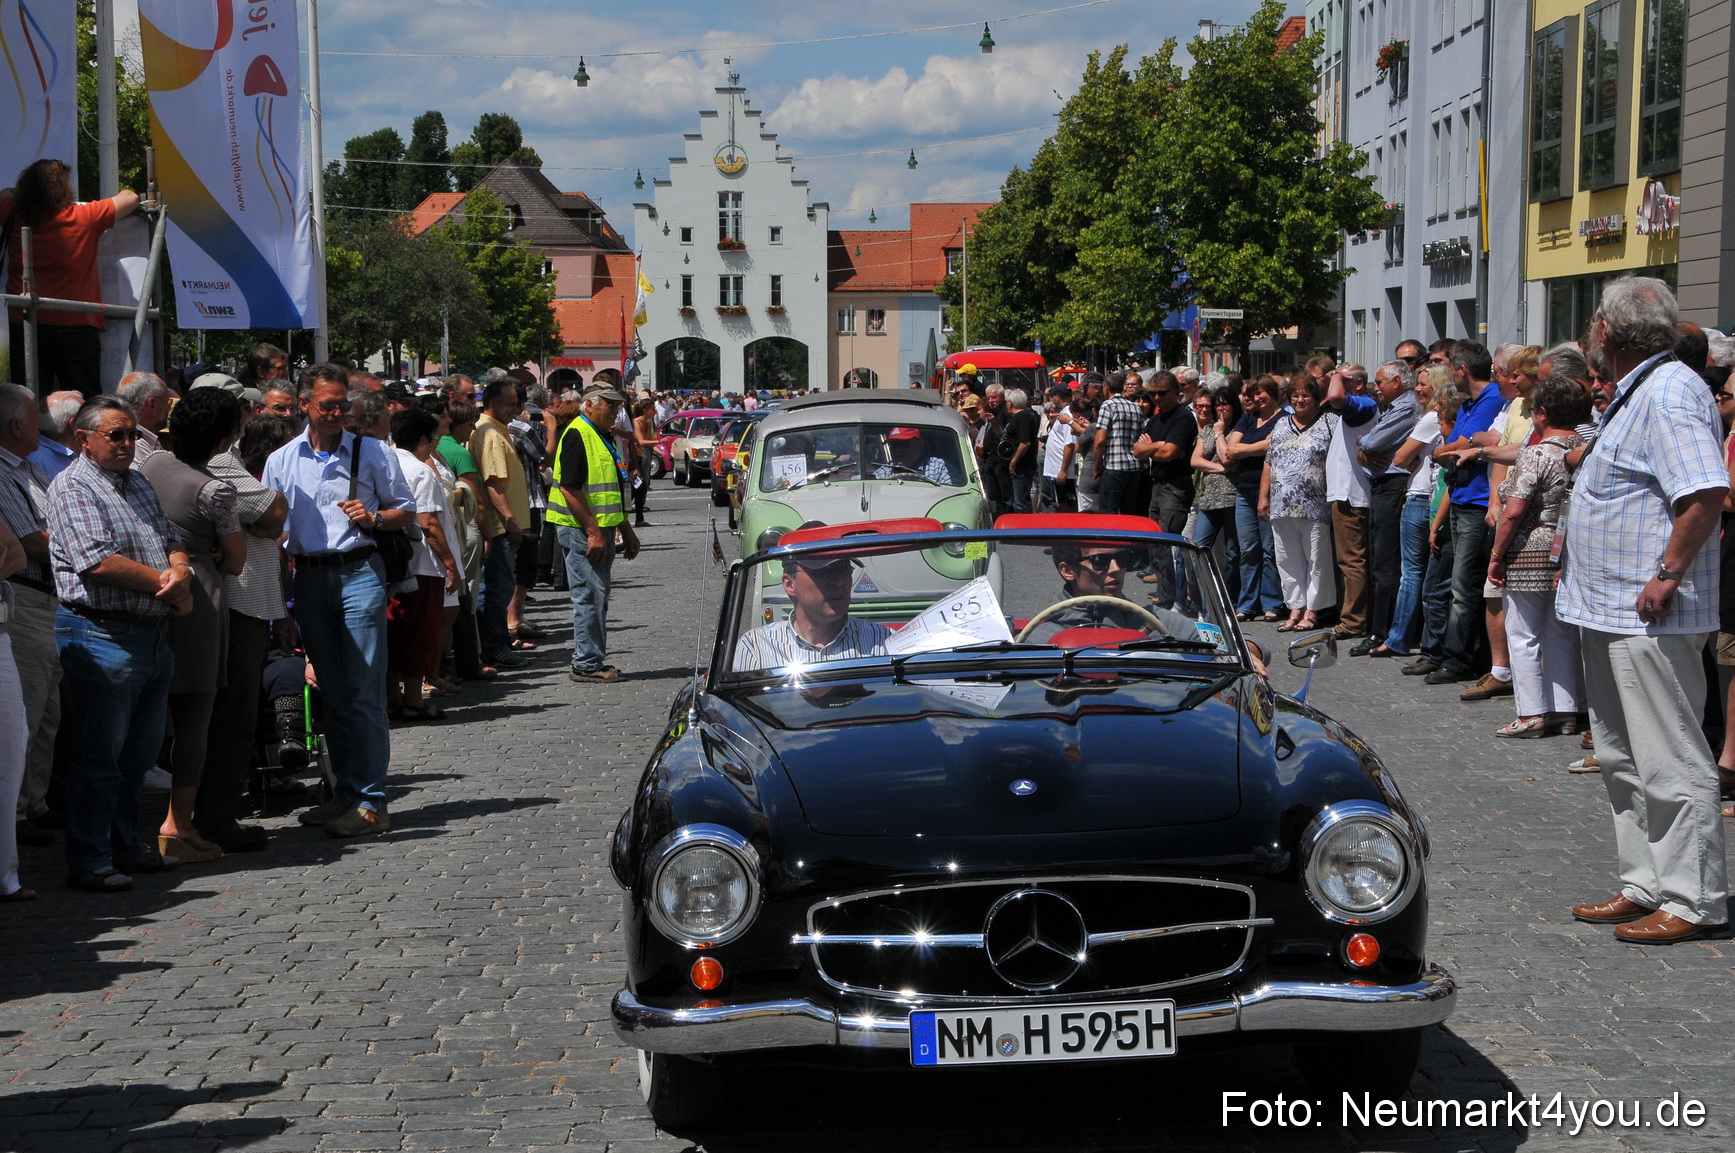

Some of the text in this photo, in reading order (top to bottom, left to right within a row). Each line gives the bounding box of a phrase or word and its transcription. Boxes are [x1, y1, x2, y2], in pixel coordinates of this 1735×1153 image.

[781, 463, 802, 475] 156
[937, 595, 982, 625] 185
[1203, 630, 1210, 642] 3
[937, 1008, 1172, 1058] NM H 595H
[920, 1044, 929, 1056] D
